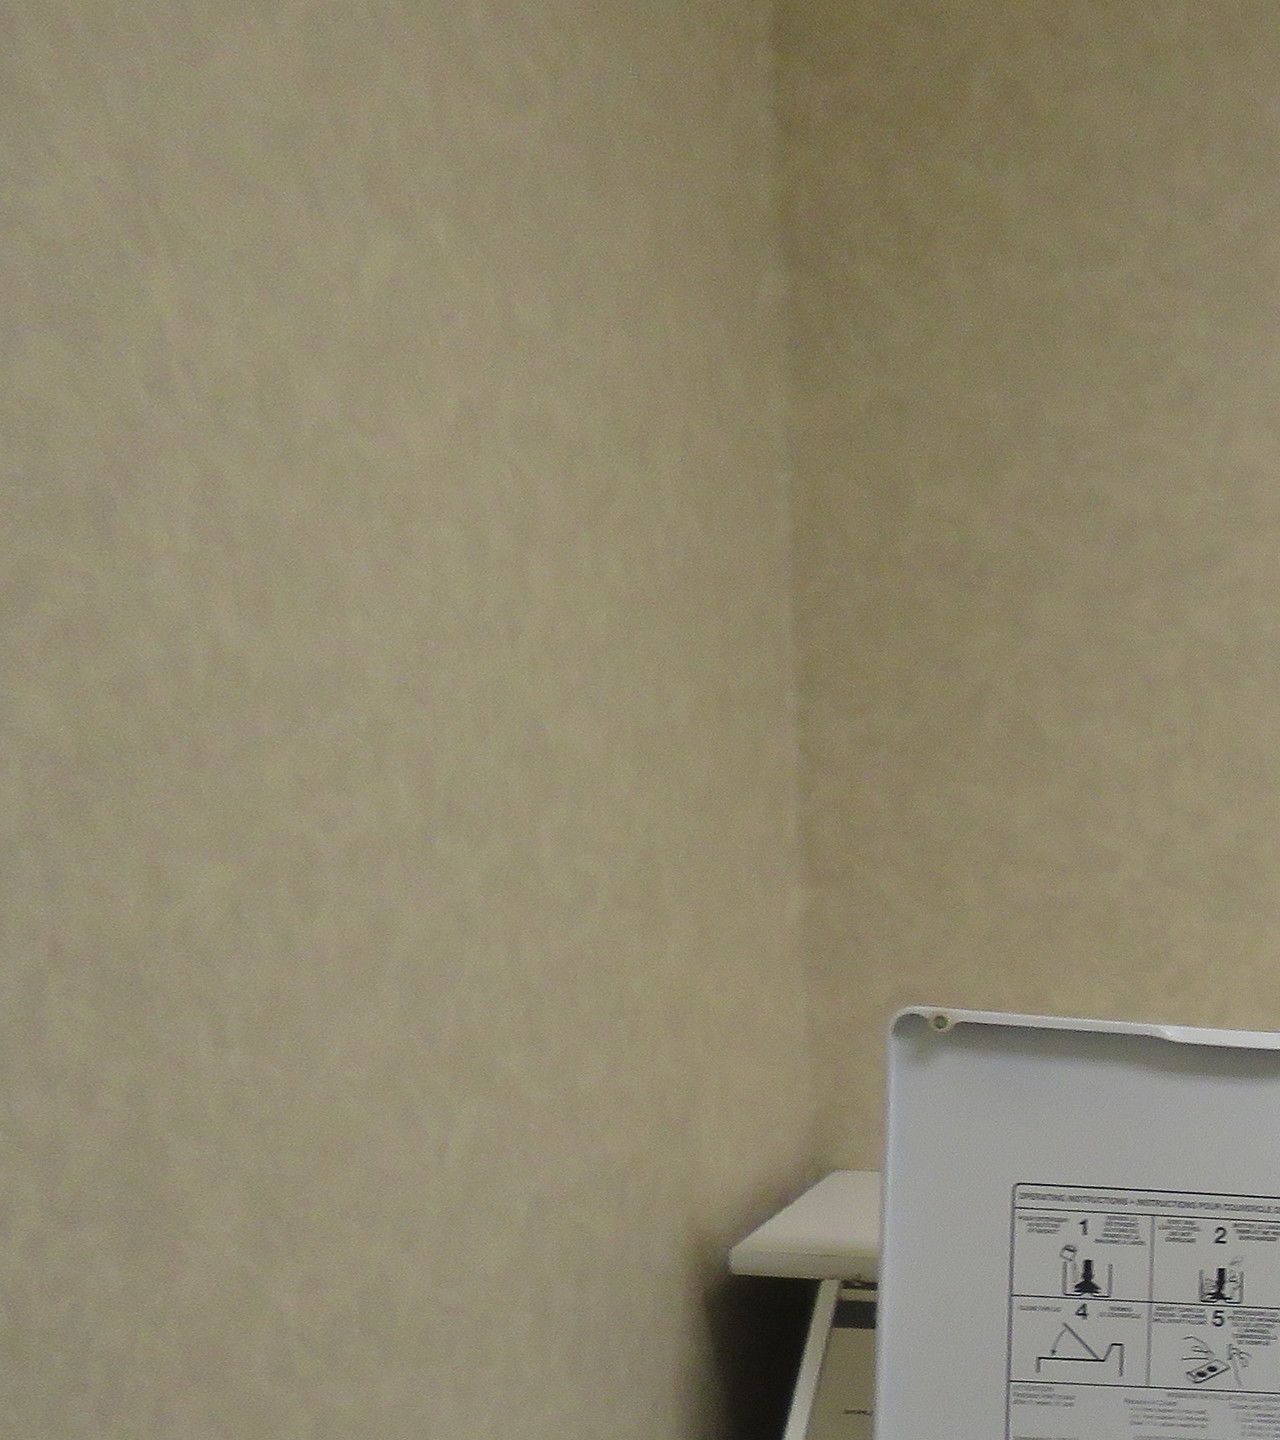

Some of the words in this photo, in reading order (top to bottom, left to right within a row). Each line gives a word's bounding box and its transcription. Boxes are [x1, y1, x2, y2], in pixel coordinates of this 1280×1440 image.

[1078, 1218, 1089, 1236] 1
[1214, 1226, 1228, 1244] 2
[1075, 1302, 1088, 1320] 4
[1211, 1309, 1225, 1327] 5
